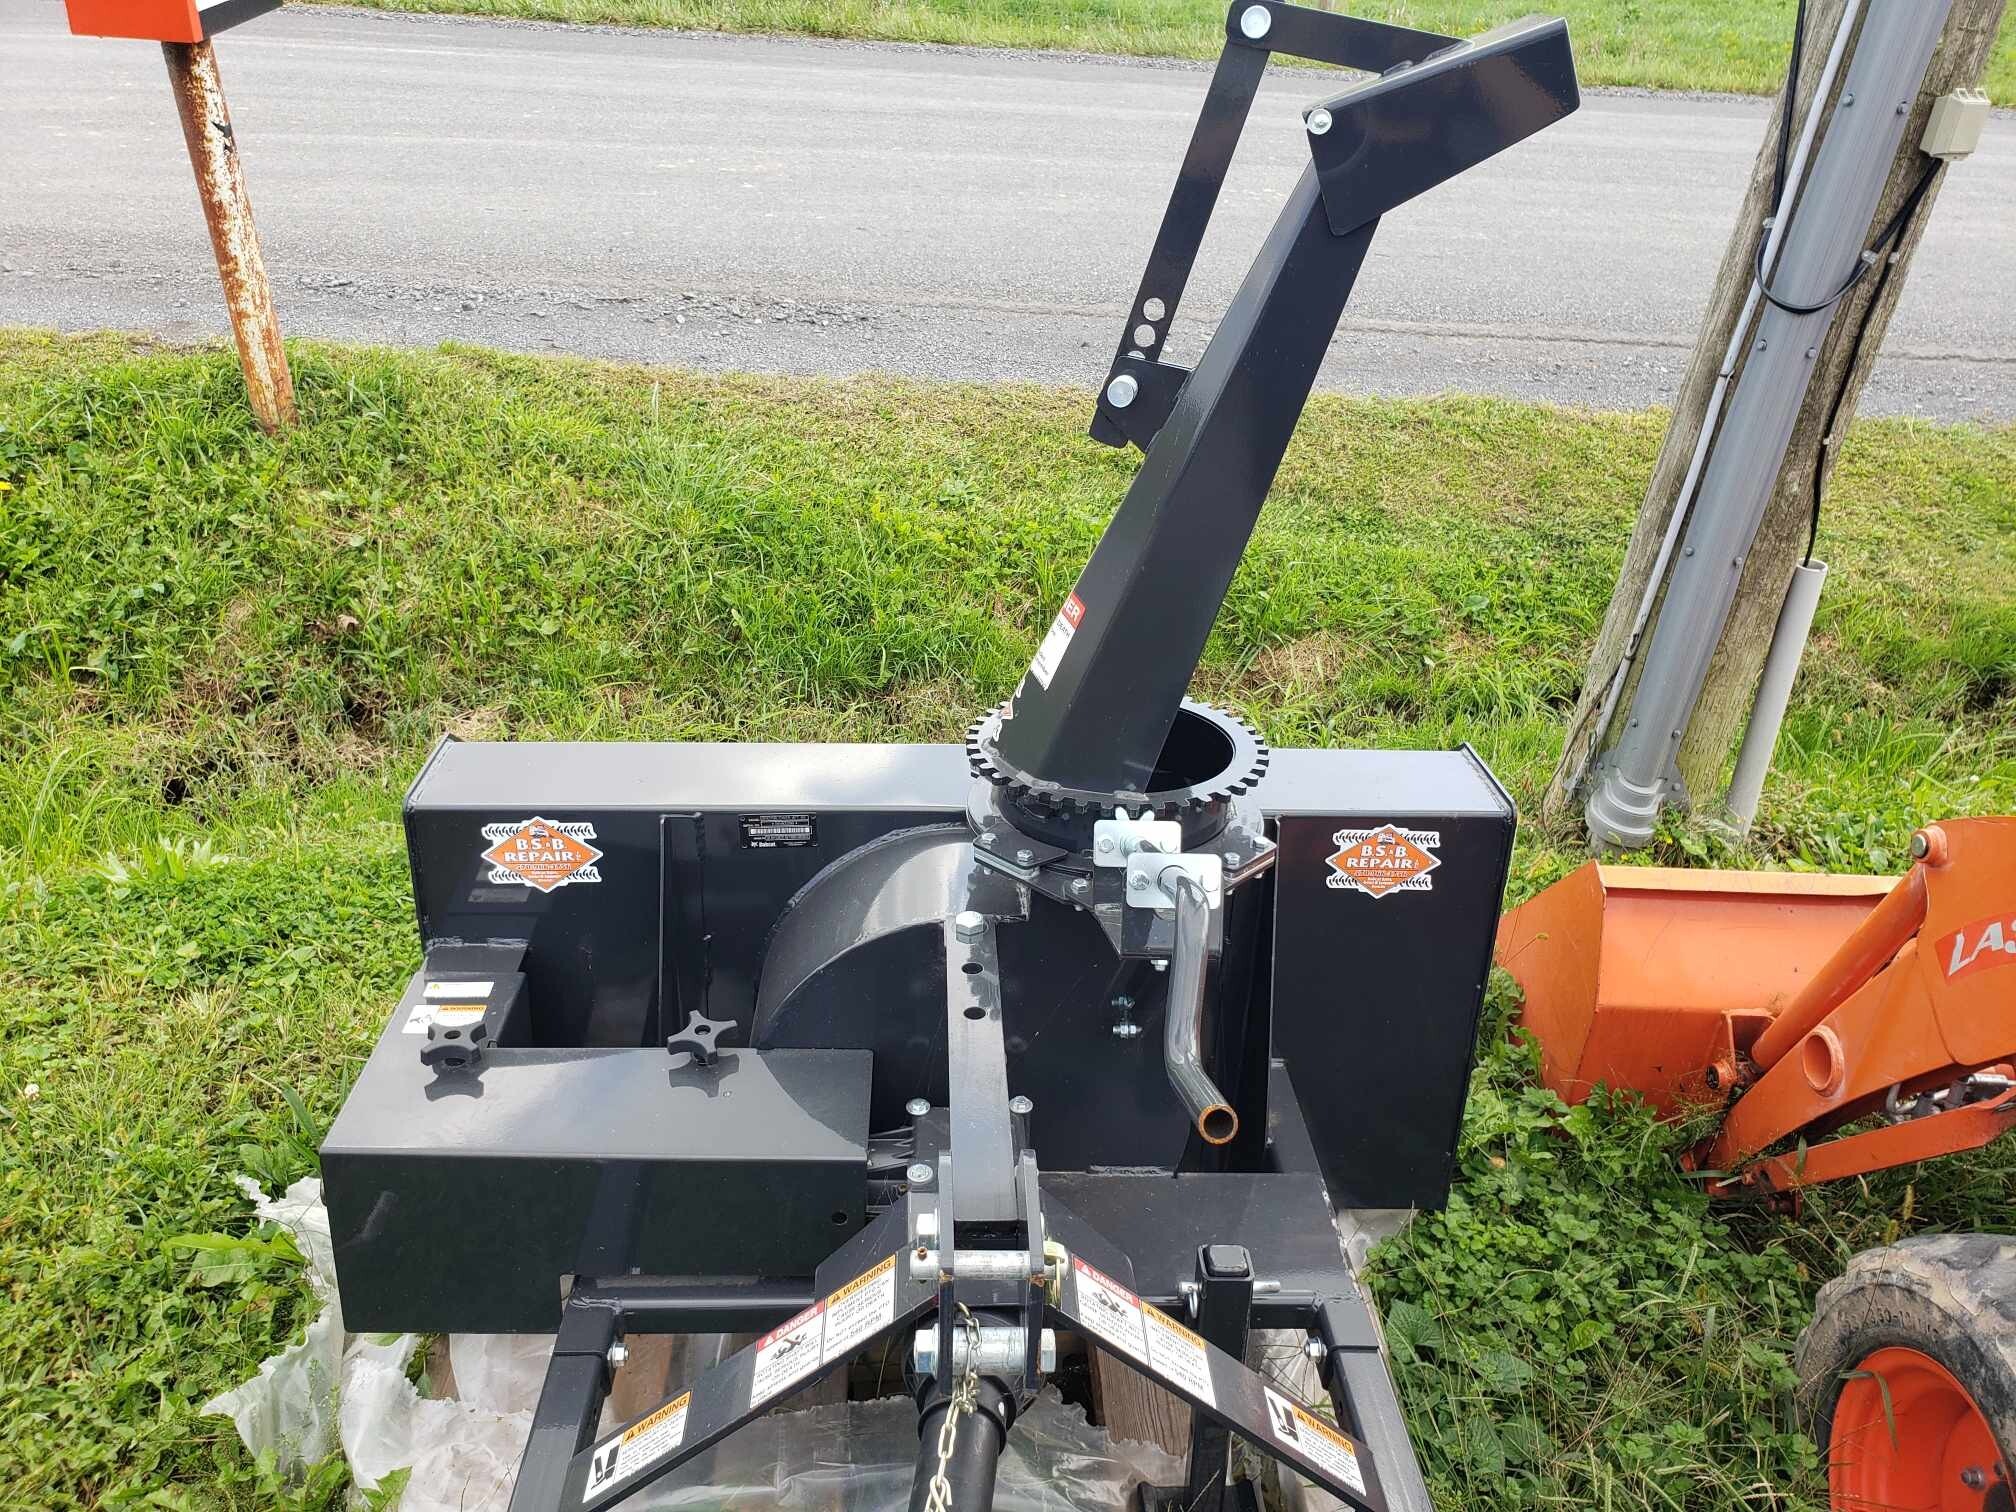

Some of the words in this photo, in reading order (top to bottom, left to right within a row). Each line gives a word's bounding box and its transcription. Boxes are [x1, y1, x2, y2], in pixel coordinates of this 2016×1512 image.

[504, 852, 573, 862] REPAIR
[1346, 858, 1412, 869] REPAIR
[842, 1259, 891, 1295] WARNING
[1092, 1270, 1132, 1302] DANGER
[775, 1306, 817, 1338] DANGER
[1156, 1312, 1201, 1346] WARNING
[638, 1396, 687, 1433] WARNING
[1307, 1417, 1352, 1452] WARNING
